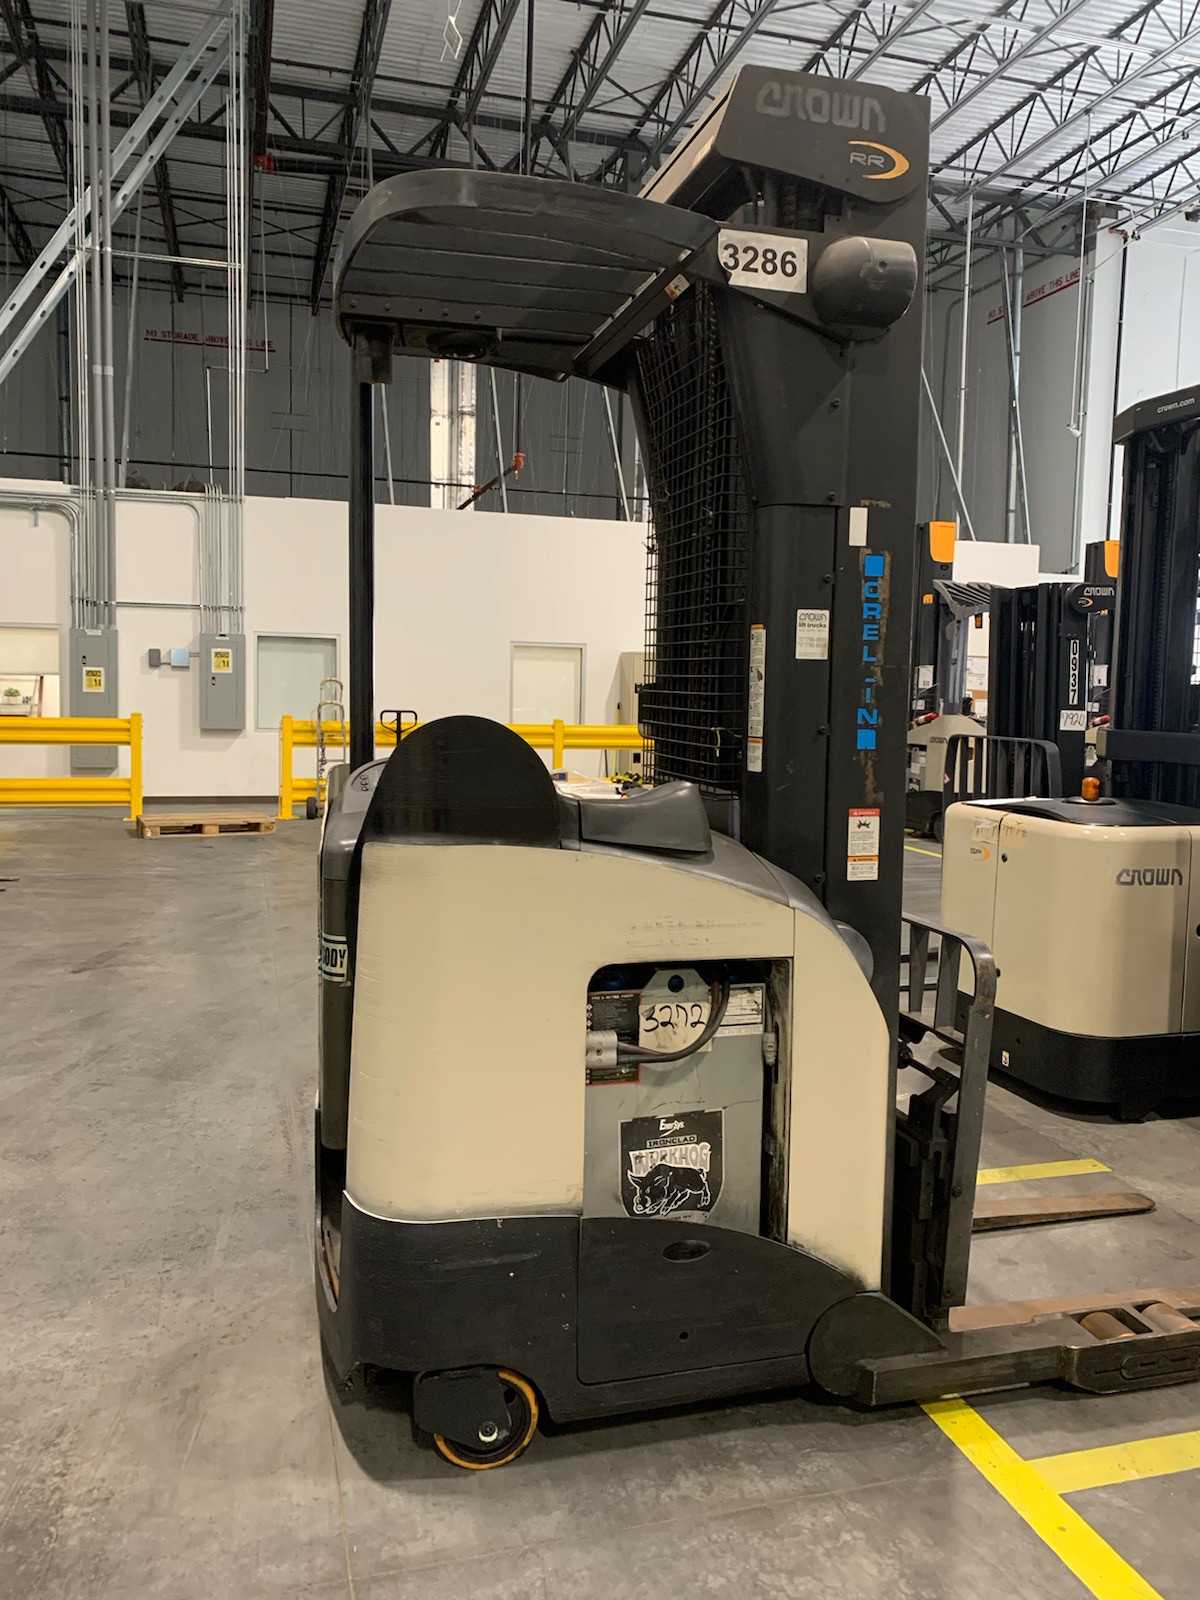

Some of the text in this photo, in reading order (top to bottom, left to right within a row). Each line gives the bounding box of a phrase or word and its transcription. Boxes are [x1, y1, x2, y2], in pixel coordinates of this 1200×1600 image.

[849, 151, 885, 169] RR
[722, 243, 798, 278] 3286
[1070, 640, 1079, 705] 0937
[643, 1003, 706, 1032] 3272
[647, 1135, 696, 1147] IRONCLAD
